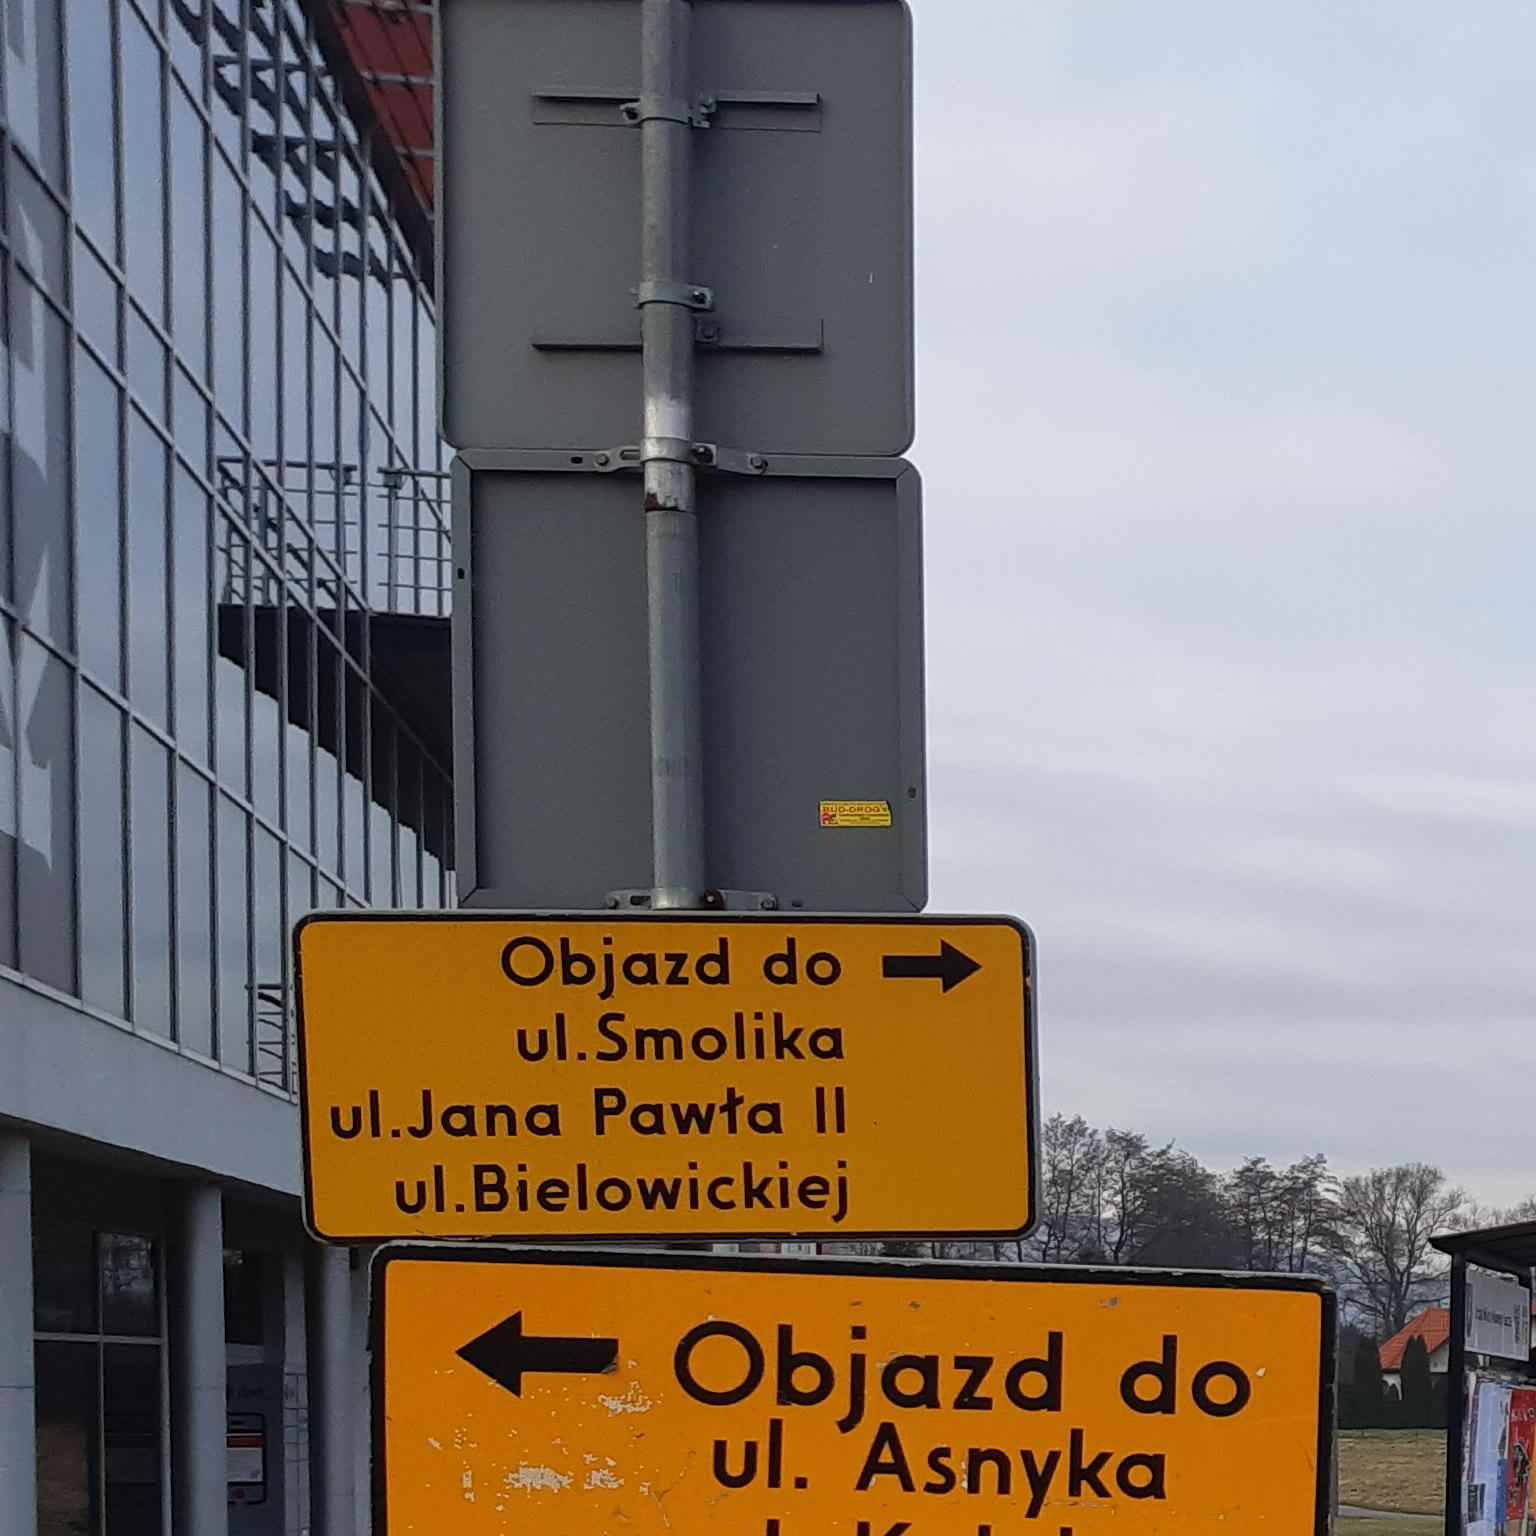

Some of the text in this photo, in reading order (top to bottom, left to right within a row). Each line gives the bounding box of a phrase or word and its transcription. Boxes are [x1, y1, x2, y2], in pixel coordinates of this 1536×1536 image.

[501, 936, 842, 1000] Objazd do
[594, 1087, 783, 1136] Pawła
[815, 1086, 846, 1134] II
[674, 1321, 1251, 1434] Objazd do
[713, 1418, 1166, 1519] ul. Asnyka
